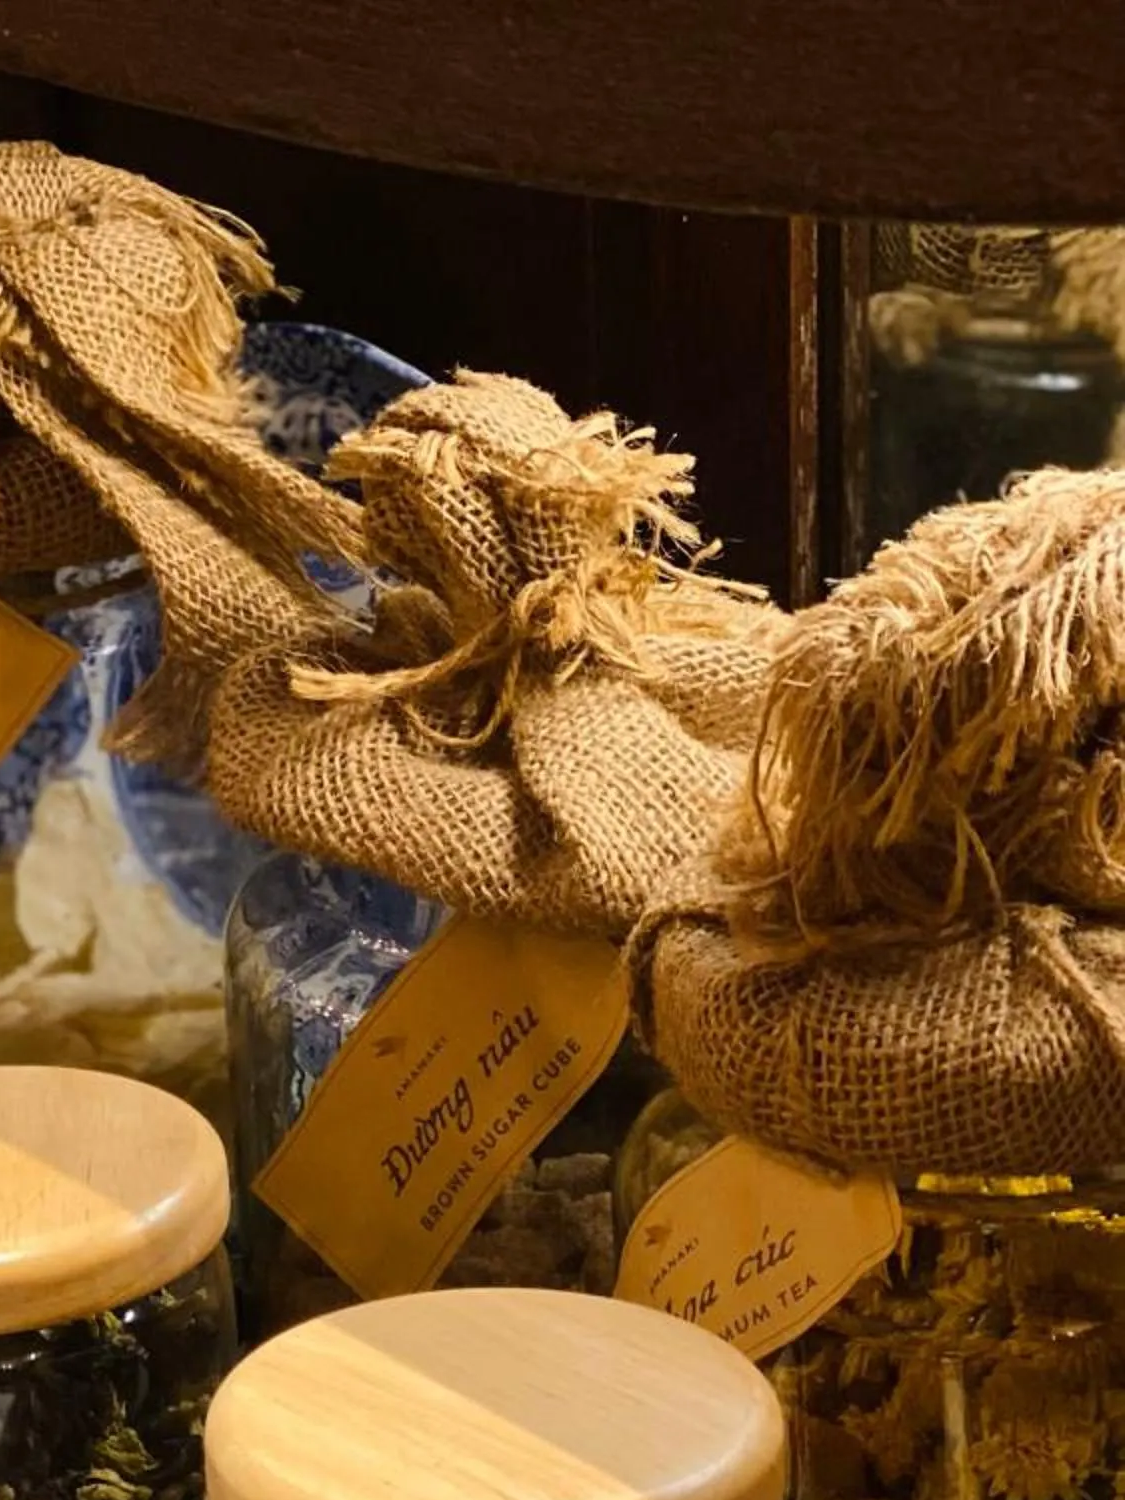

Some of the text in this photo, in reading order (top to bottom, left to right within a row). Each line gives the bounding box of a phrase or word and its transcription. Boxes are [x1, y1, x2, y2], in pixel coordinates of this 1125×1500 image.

[381, 1005, 539, 1198] Đường nâu
[420, 1037, 583, 1232] BROWN SUGAR CUBE
[735, 1225, 796, 1287] cúc
[777, 1274, 818, 1309] TEA
